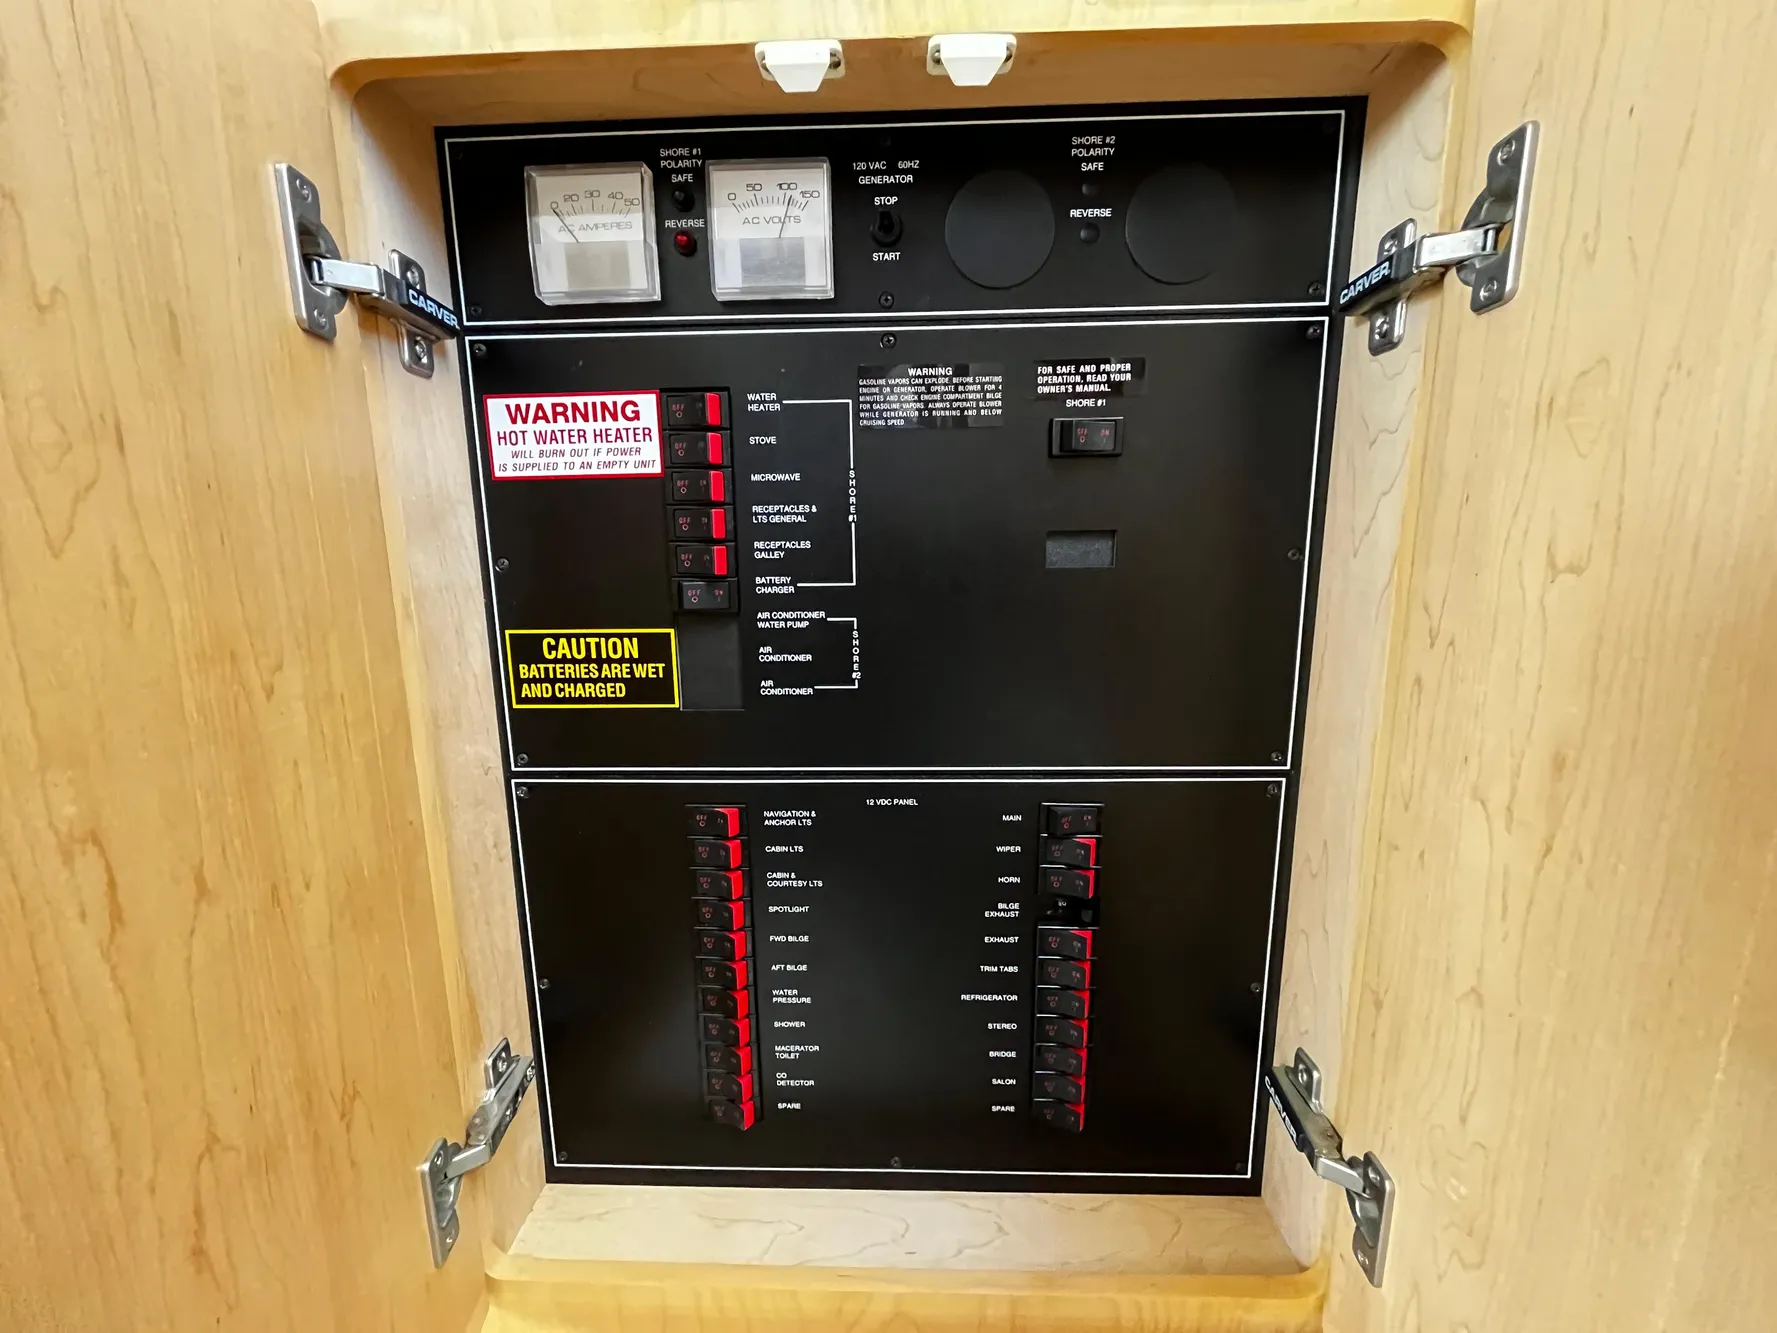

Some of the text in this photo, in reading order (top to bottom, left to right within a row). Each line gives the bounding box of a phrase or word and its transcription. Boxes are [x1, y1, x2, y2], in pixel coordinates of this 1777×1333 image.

[1072, 136, 1103, 144] SHORE
[660, 148, 689, 156] SHORE
[1072, 148, 1114, 156] POLARITY
[661, 159, 702, 168] POLARITY
[853, 160, 919, 170] 120 VAC 60HZ
[1081, 162, 1103, 171] SAFE
[672, 174, 693, 182] SAFE
[859, 175, 913, 184] GENERATOR
[746, 183, 763, 192] 50
[776, 182, 798, 191] 100
[563, 193, 579, 202] 20
[584, 190, 601, 199] 30
[607, 191, 624, 201] 40
[800, 190, 820, 200] 150
[623, 197, 640, 207] 50
[875, 197, 898, 205] STOP
[1070, 209, 1112, 217] REVERSE
[665, 219, 704, 227] REVERSE
[742, 214, 802, 225] AC VOLTS
[558, 220, 633, 234] AC AMPERES
[873, 252, 900, 261] START
[1339, 261, 1391, 305] CARVER
[407, 289, 460, 330] CARVER
[908, 367, 952, 376] WARNING
[1038, 366, 1052, 374] FOR
[1100, 363, 1131, 371] PROPER
[1038, 373, 1131, 384] OPERATION, READ YOUR
[1038, 384, 1111, 393] OWNER'S MANUAL.
[748, 403, 780, 411] HEATER
[1066, 399, 1095, 407] SHORE
[505, 400, 640, 424] WARNING
[497, 427, 652, 446] HOT WATER HEATER
[510, 446, 642, 459] WILL BURN OUT IF POWER
[498, 458, 657, 471] IS SUPPLIED TO AN EMPTY UNIT
[751, 473, 800, 481] MICROWAVE
[752, 505, 809, 513] RECEPTACLES
[754, 541, 811, 549] RECEPTACLES
[772, 611, 825, 619] CONDITIONER
[543, 638, 638, 659] CAUTION
[759, 654, 812, 662] CONDITIONER
[519, 664, 665, 678] BATTERIES ARE WET
[522, 683, 625, 697] AND CHARGED
